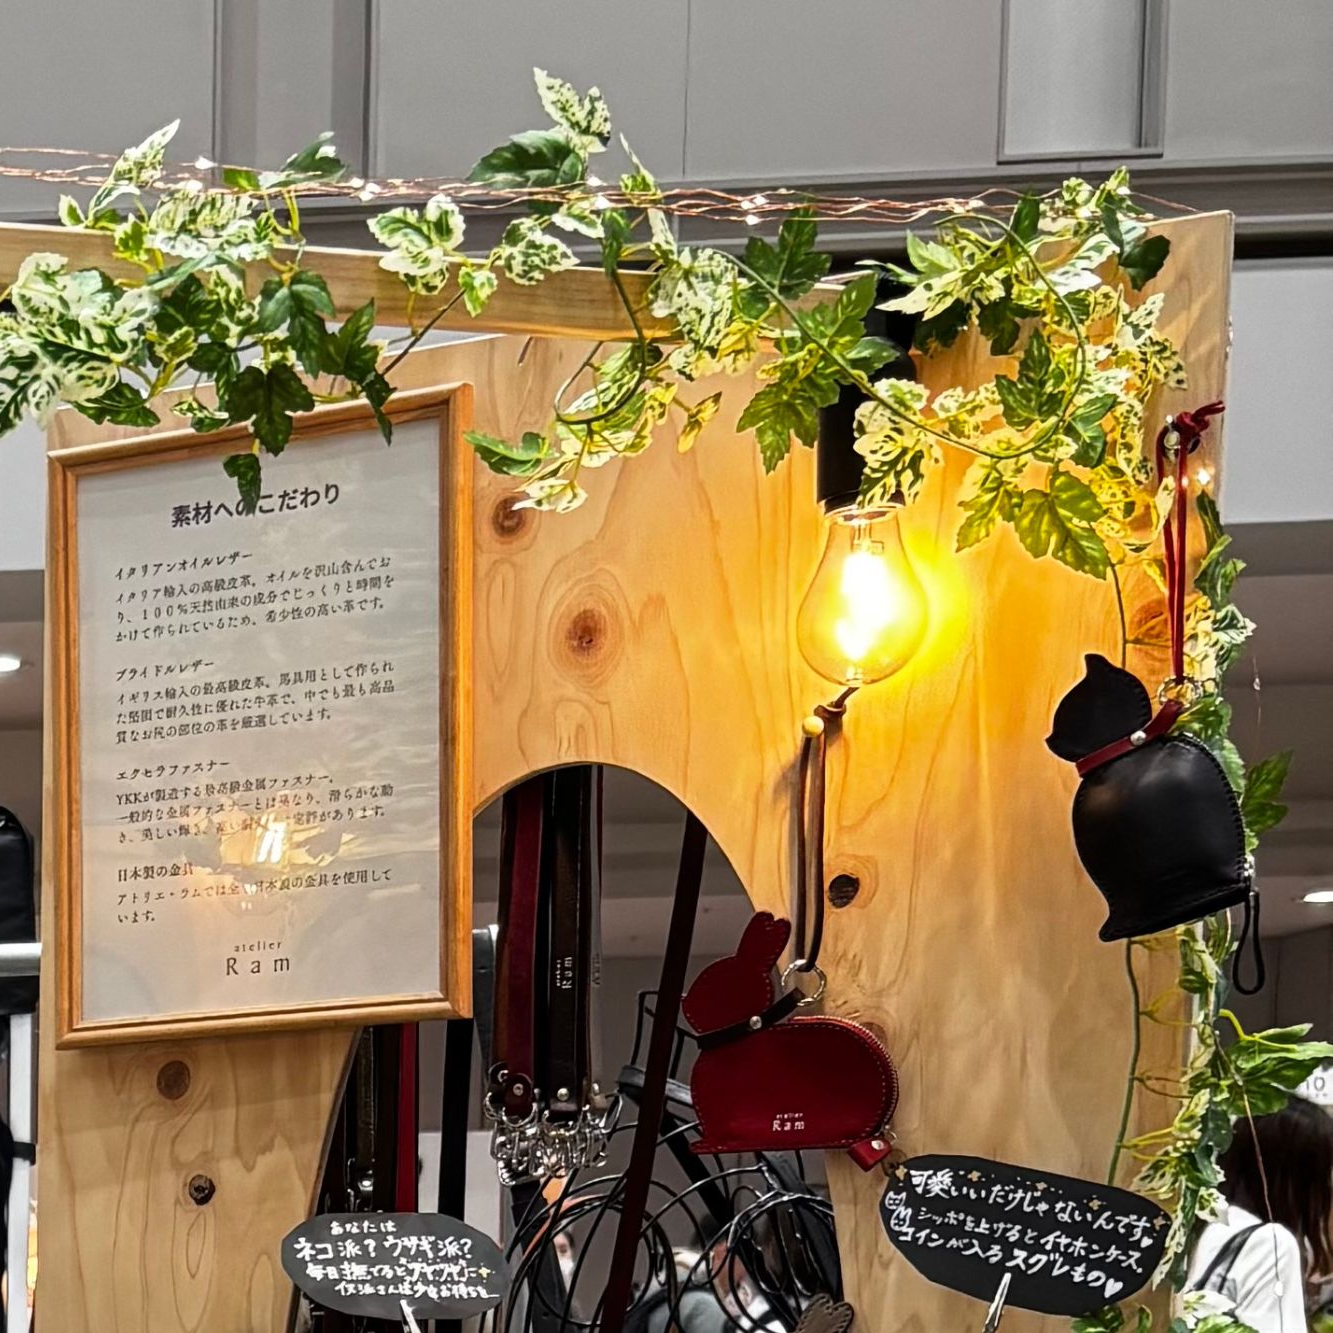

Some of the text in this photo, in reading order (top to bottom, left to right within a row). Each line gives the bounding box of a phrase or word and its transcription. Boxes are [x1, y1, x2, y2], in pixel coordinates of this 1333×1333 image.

[116, 551, 252, 580] イタリアンオイルレザー
[233, 939, 282, 953] atelier
[226, 956, 290, 976] Ram
[773, 1119, 806, 1131] Ram
[330, 1220, 397, 1236] あなたは
